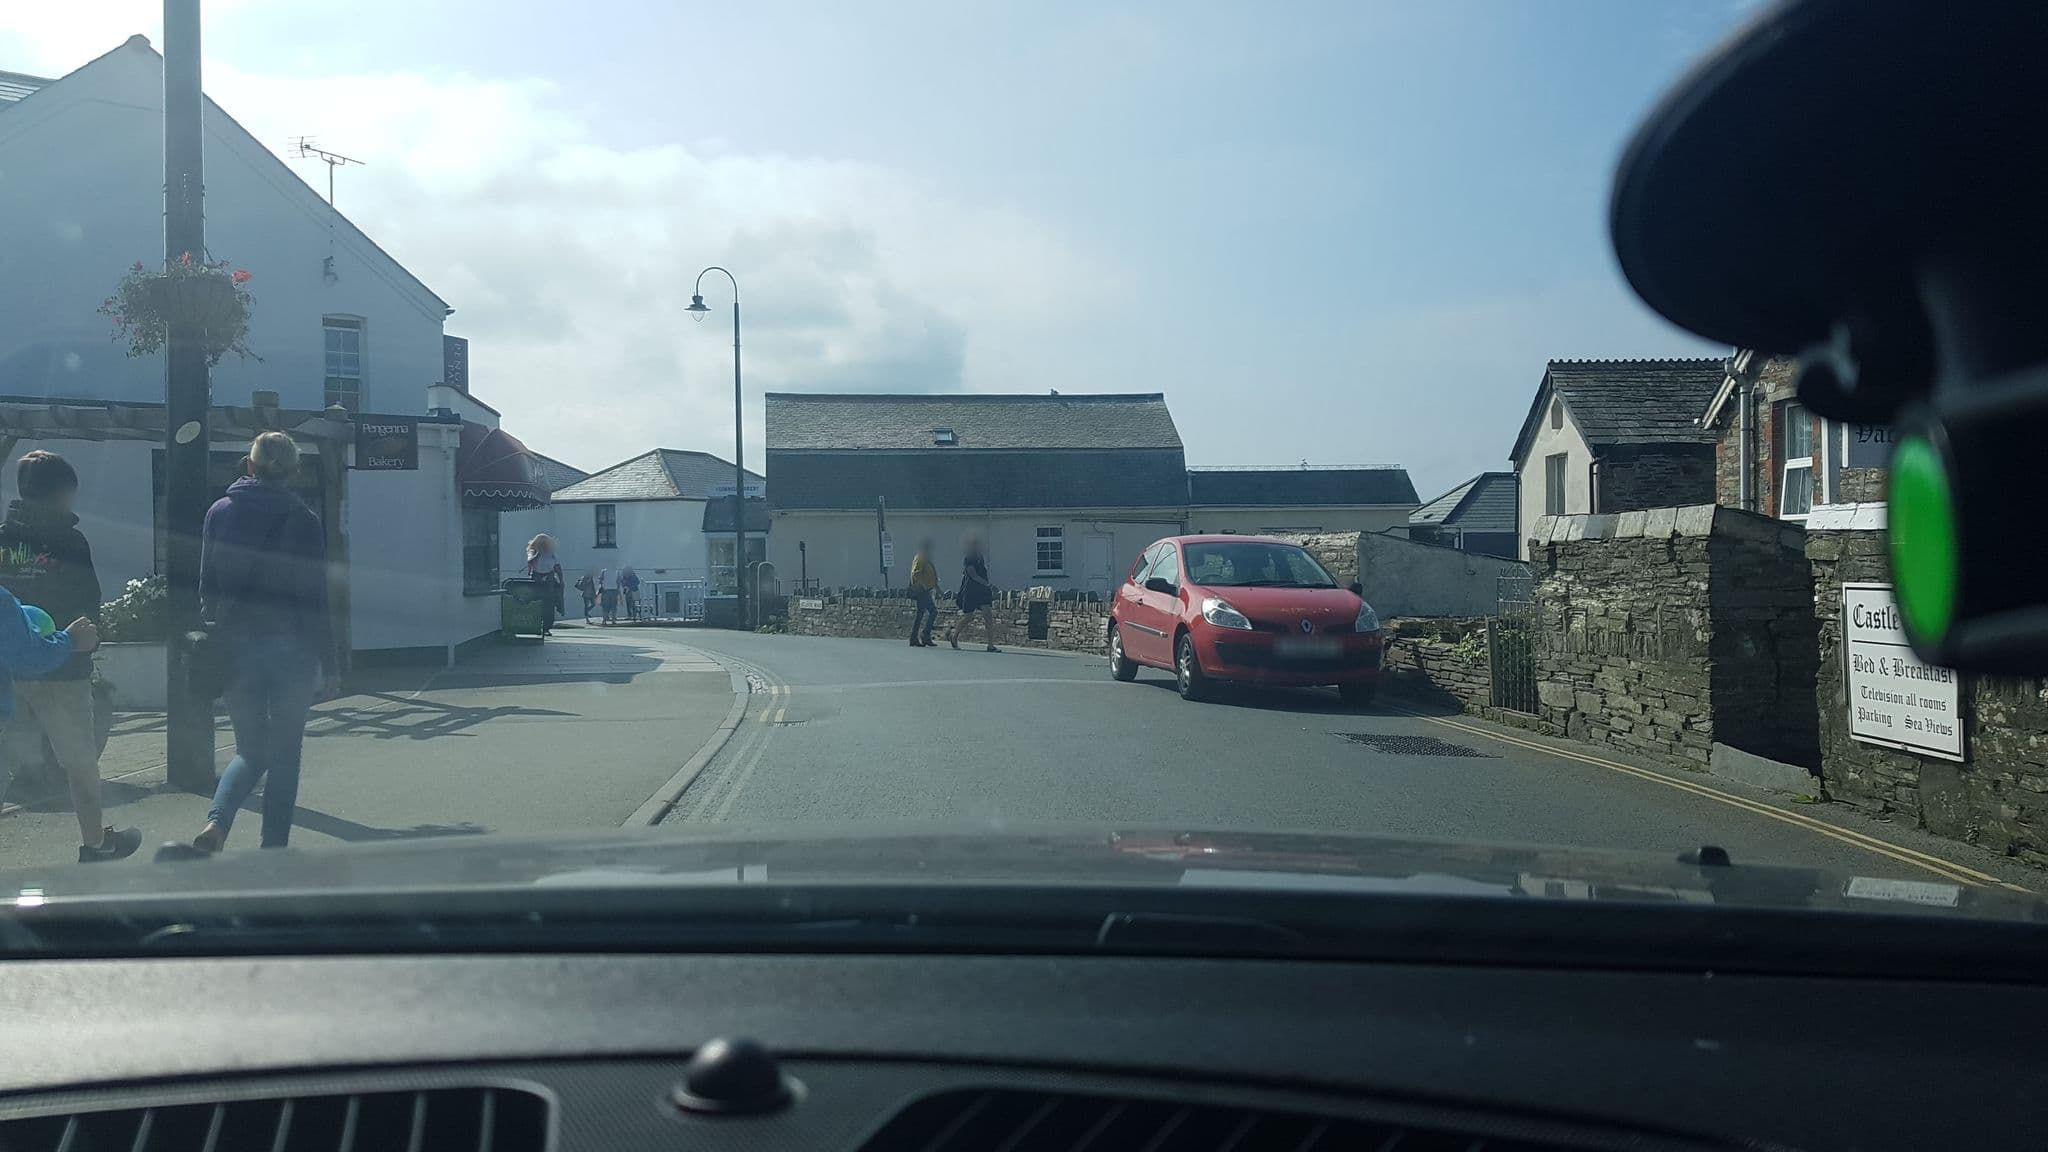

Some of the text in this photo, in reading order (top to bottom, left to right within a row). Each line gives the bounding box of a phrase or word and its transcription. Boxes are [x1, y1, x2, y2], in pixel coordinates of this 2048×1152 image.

[362, 423, 409, 436] Pengenna
[368, 456, 405, 468] Bakery
[1853, 653, 1875, 674] Bed
[1878, 657, 1889, 676] &
[1860, 685, 1947, 712] Television all rooms
[1857, 706, 1953, 736] Parking Sea Views
